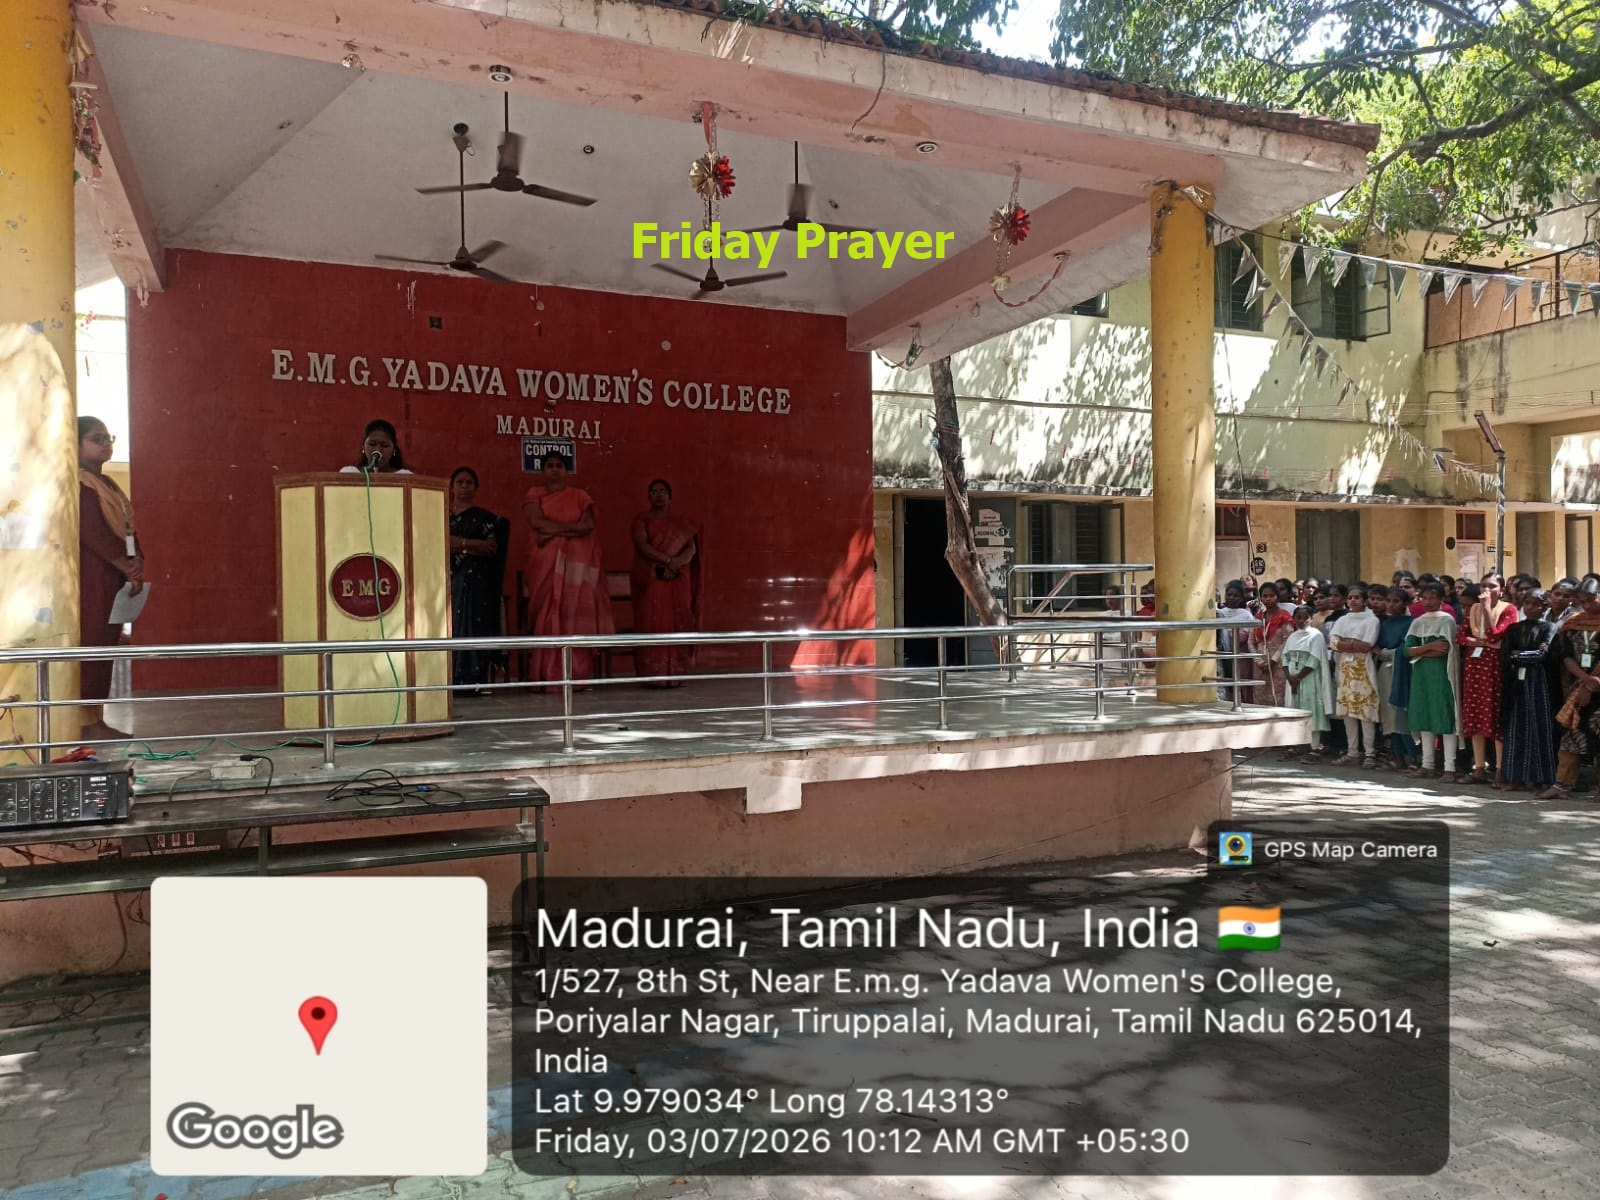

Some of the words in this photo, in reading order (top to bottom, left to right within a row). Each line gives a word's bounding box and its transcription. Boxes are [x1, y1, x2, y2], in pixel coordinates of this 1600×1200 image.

[517, 369, 653, 406] WOMEN'S
[663, 380, 791, 414] COLLEGE
[496, 415, 600, 439] MADURAI
